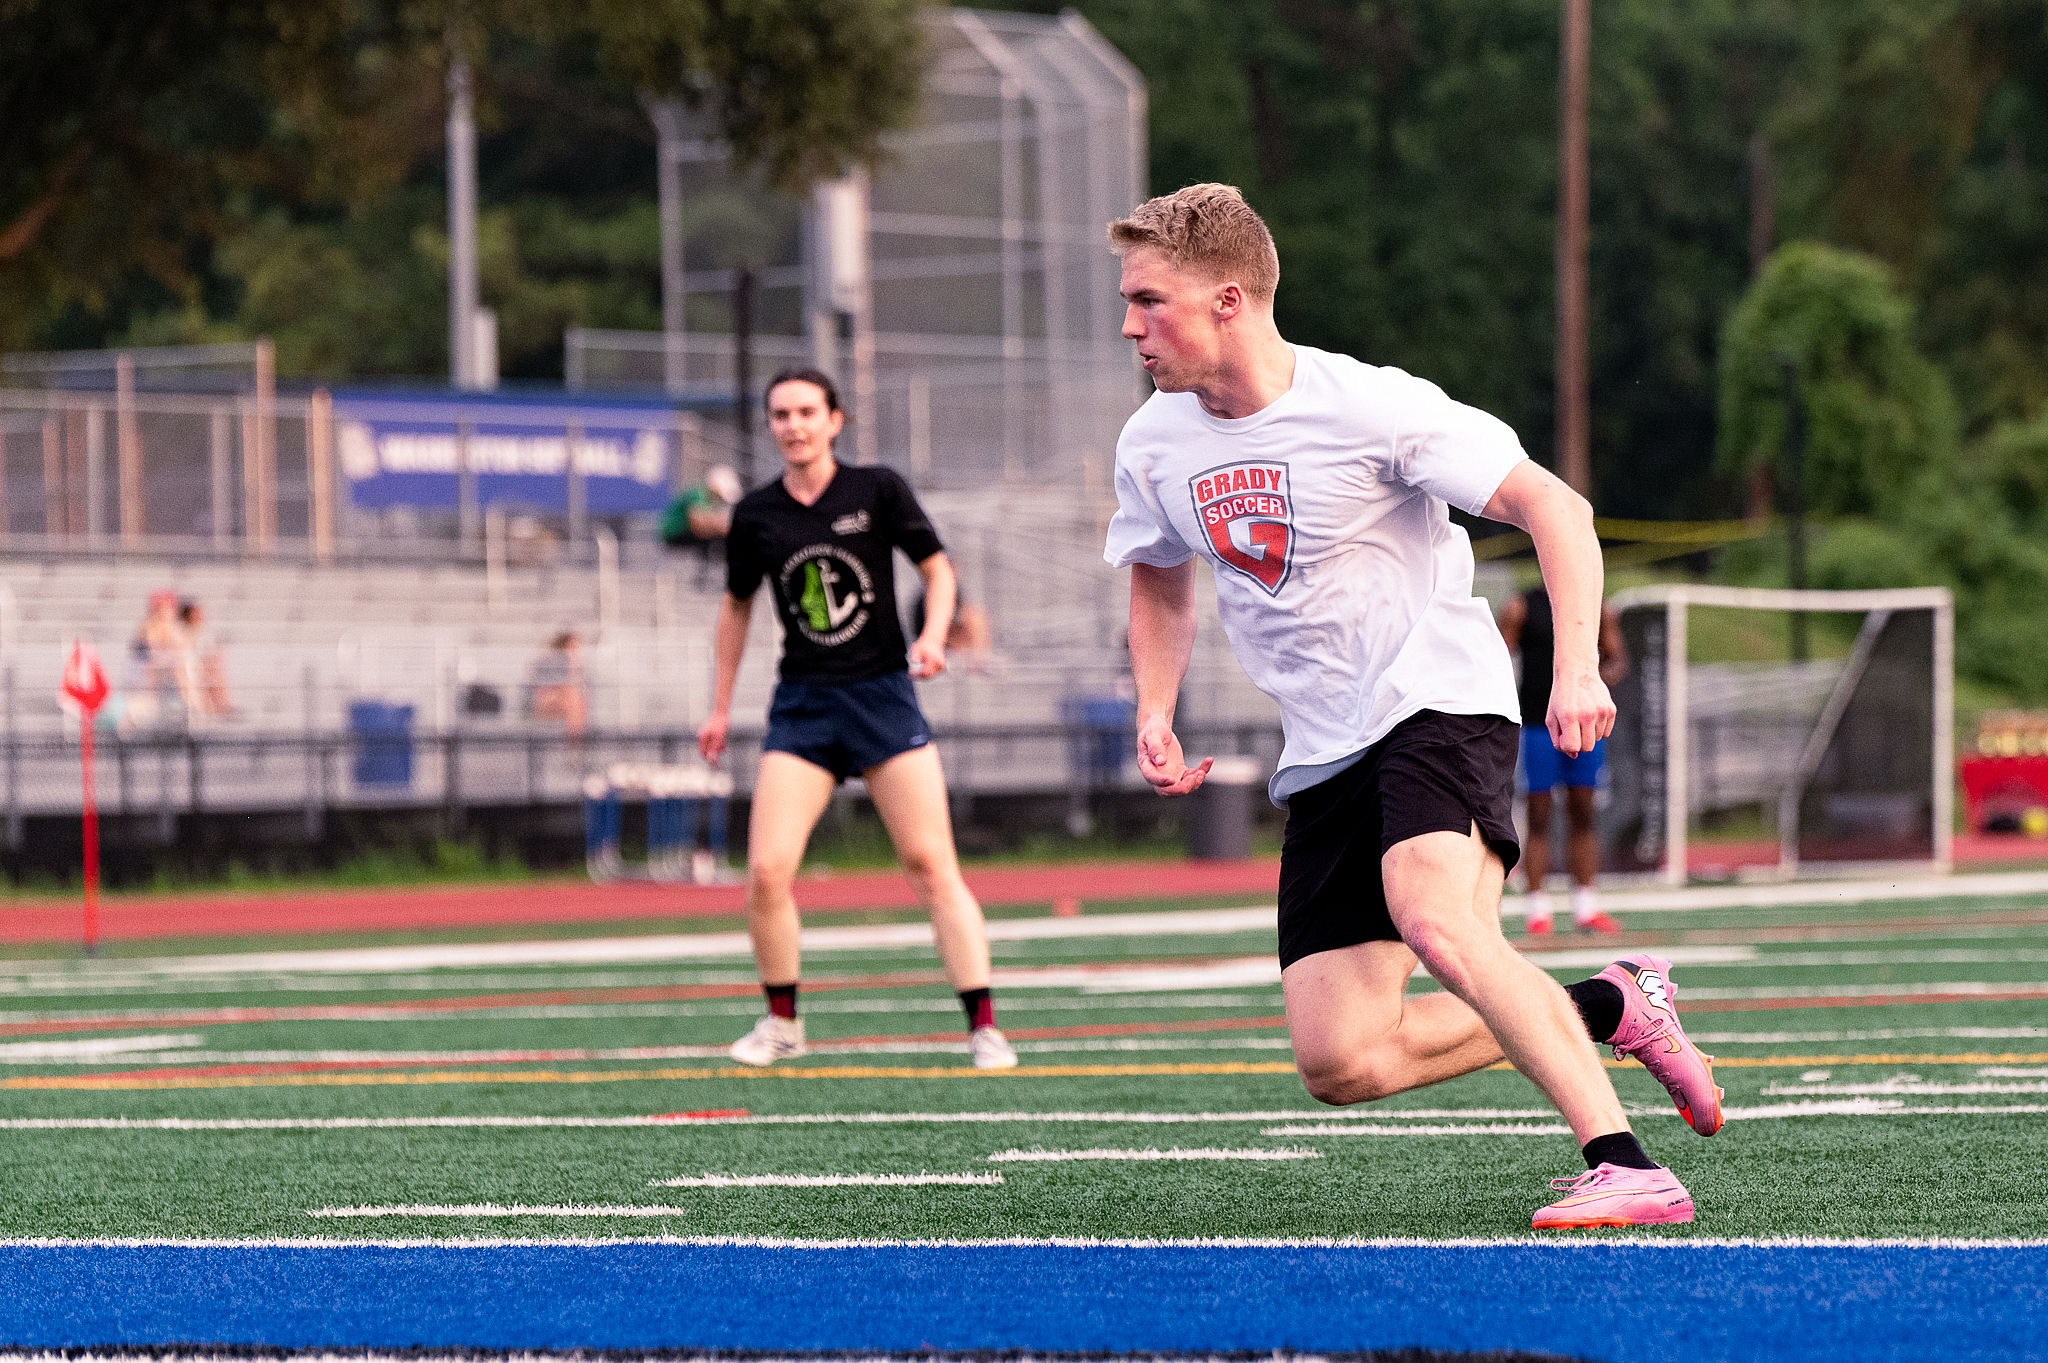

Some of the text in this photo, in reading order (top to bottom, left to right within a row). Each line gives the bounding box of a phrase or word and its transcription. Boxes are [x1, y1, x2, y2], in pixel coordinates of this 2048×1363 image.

[1196, 468, 1282, 503] GRADY
[1205, 496, 1284, 525] SOCCER
[1201, 495, 1288, 587] G
